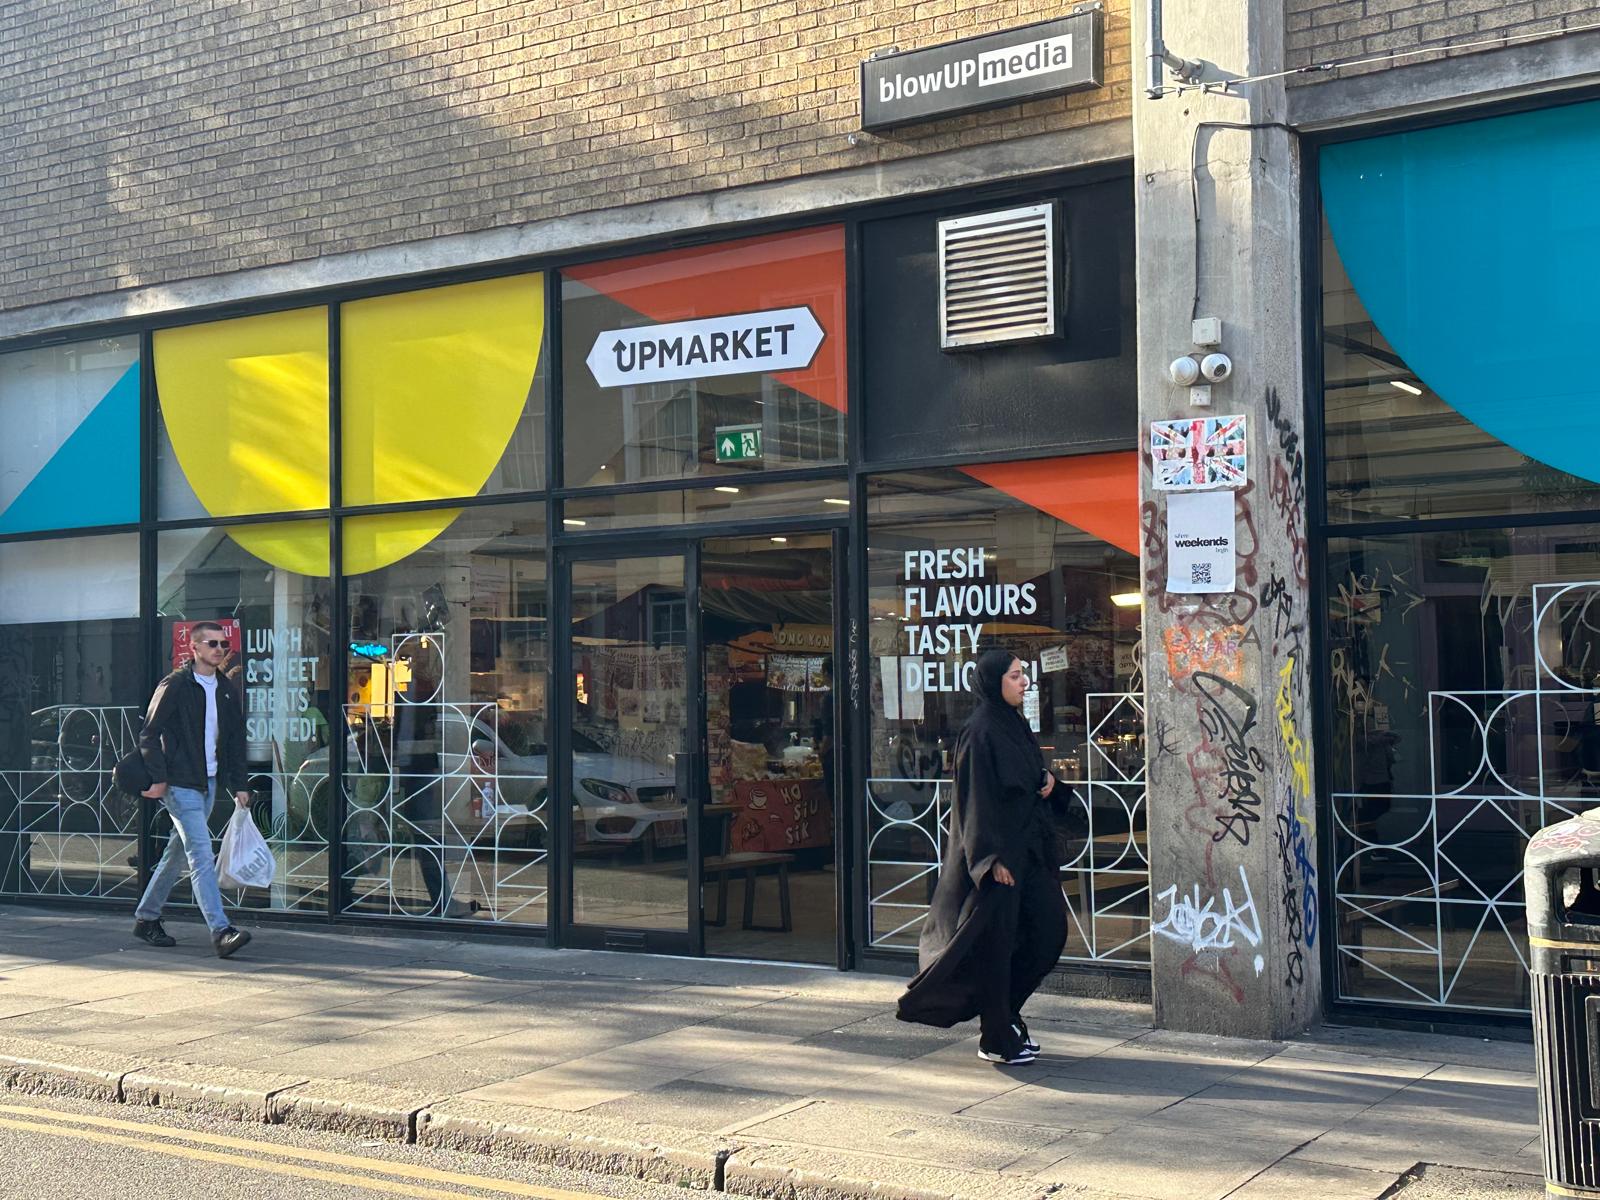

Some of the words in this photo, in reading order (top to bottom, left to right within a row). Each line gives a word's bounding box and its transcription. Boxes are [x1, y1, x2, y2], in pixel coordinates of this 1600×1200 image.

[879, 59, 977, 103] blowUP
[981, 41, 1067, 82] media
[612, 323, 795, 373] UPMARKET
[1174, 536, 1229, 548] weekends
[904, 547, 985, 581] FRESH
[904, 583, 1037, 618] FLAVOURS
[903, 623, 983, 656] TASTY
[246, 658, 258, 683] &
